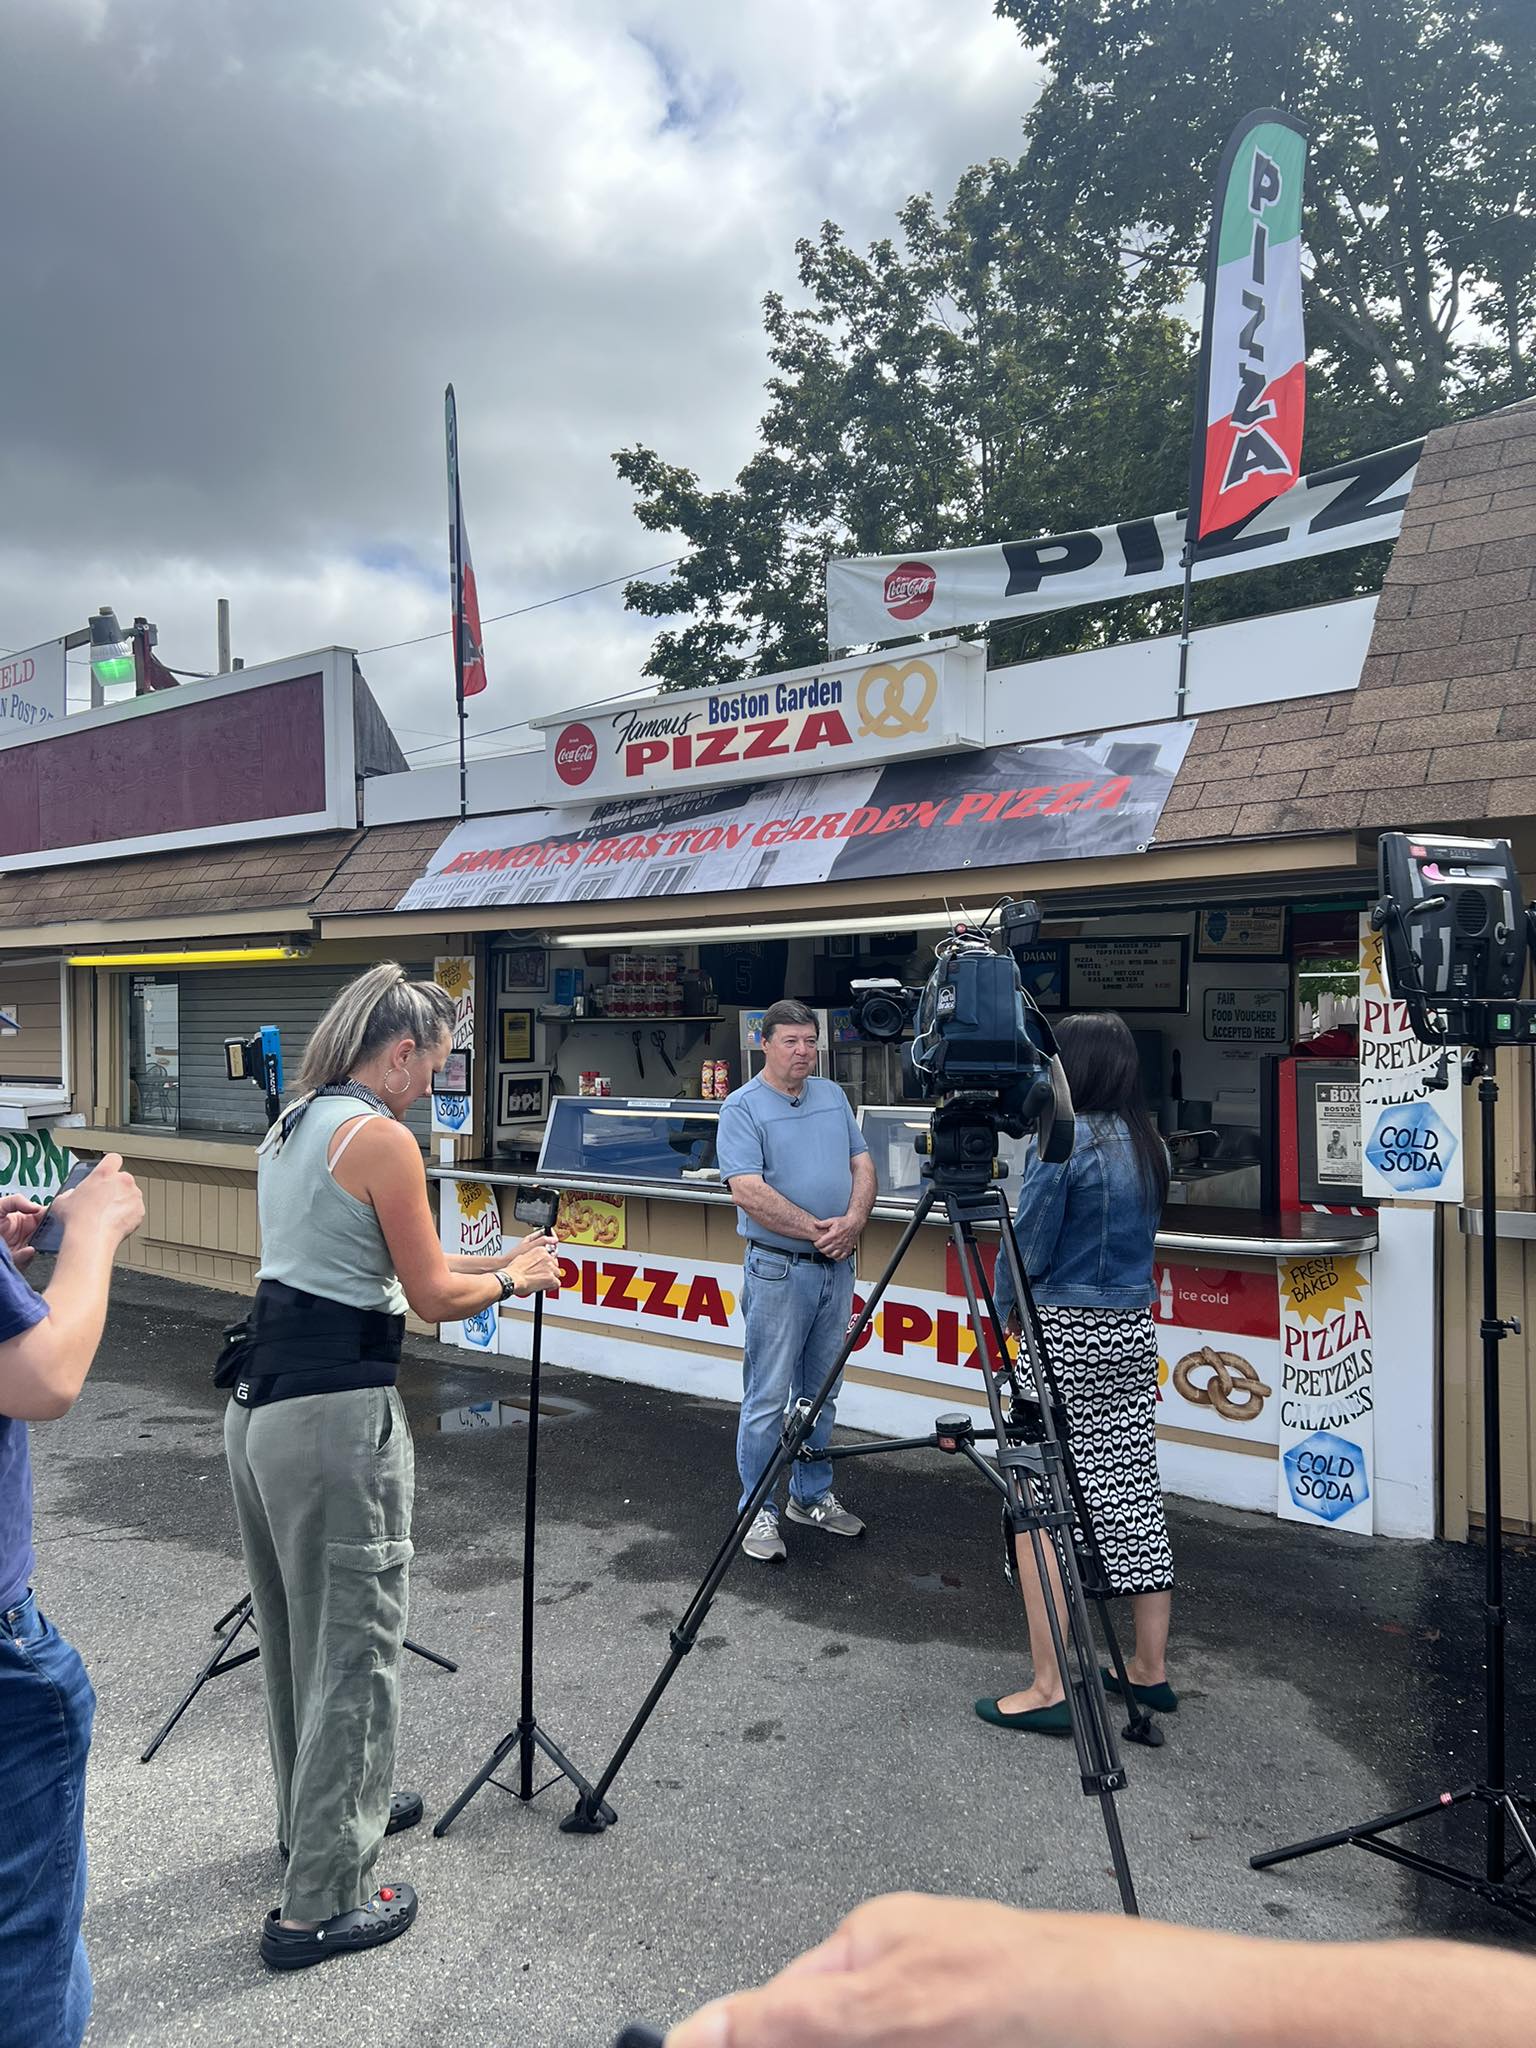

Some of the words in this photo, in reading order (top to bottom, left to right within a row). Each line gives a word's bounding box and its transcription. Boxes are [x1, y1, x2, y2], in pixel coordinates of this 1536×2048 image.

[1221, 146, 1293, 493] PIZZA
[10, 694, 37, 725] POST
[708, 691, 769, 726] Boston
[775, 678, 842, 715] Garden
[612, 709, 703, 754] Famous
[625, 709, 854, 778] PIZZA
[441, 838, 588, 875] FAMOUS
[582, 823, 752, 866] BOSTON
[751, 797, 948, 848] GARDEN
[944, 774, 1133, 827] PIZZA
[1023, 951, 1057, 962] DASANI
[1216, 991, 1236, 1006] FAIR
[1211, 1009, 1233, 1022] FOOD
[1233, 1008, 1277, 1023] VOUCHERS
[1363, 999, 1413, 1034] PIZ
[1211, 1025, 1252, 1039] ACCEPTED
[1253, 1026, 1276, 1040] HERE
[1330, 1088, 1361, 1102] BOX
[438, 1102, 465, 1118] SODA
[1379, 1125, 1439, 1150] COLD
[1379, 1149, 1443, 1172] SODA
[461, 1210, 499, 1246] PIZZA
[1289, 1256, 1335, 1285] FRESH
[1178, 1288, 1198, 1301] ice
[1200, 1292, 1229, 1305] cold
[1291, 1272, 1339, 1303] BAKED
[1285, 1310, 1372, 1362] PIZZA
[1281, 1348, 1373, 1397] PRETZELS
[1296, 1451, 1355, 1479] COLD
[1295, 1475, 1355, 1504] SODA
